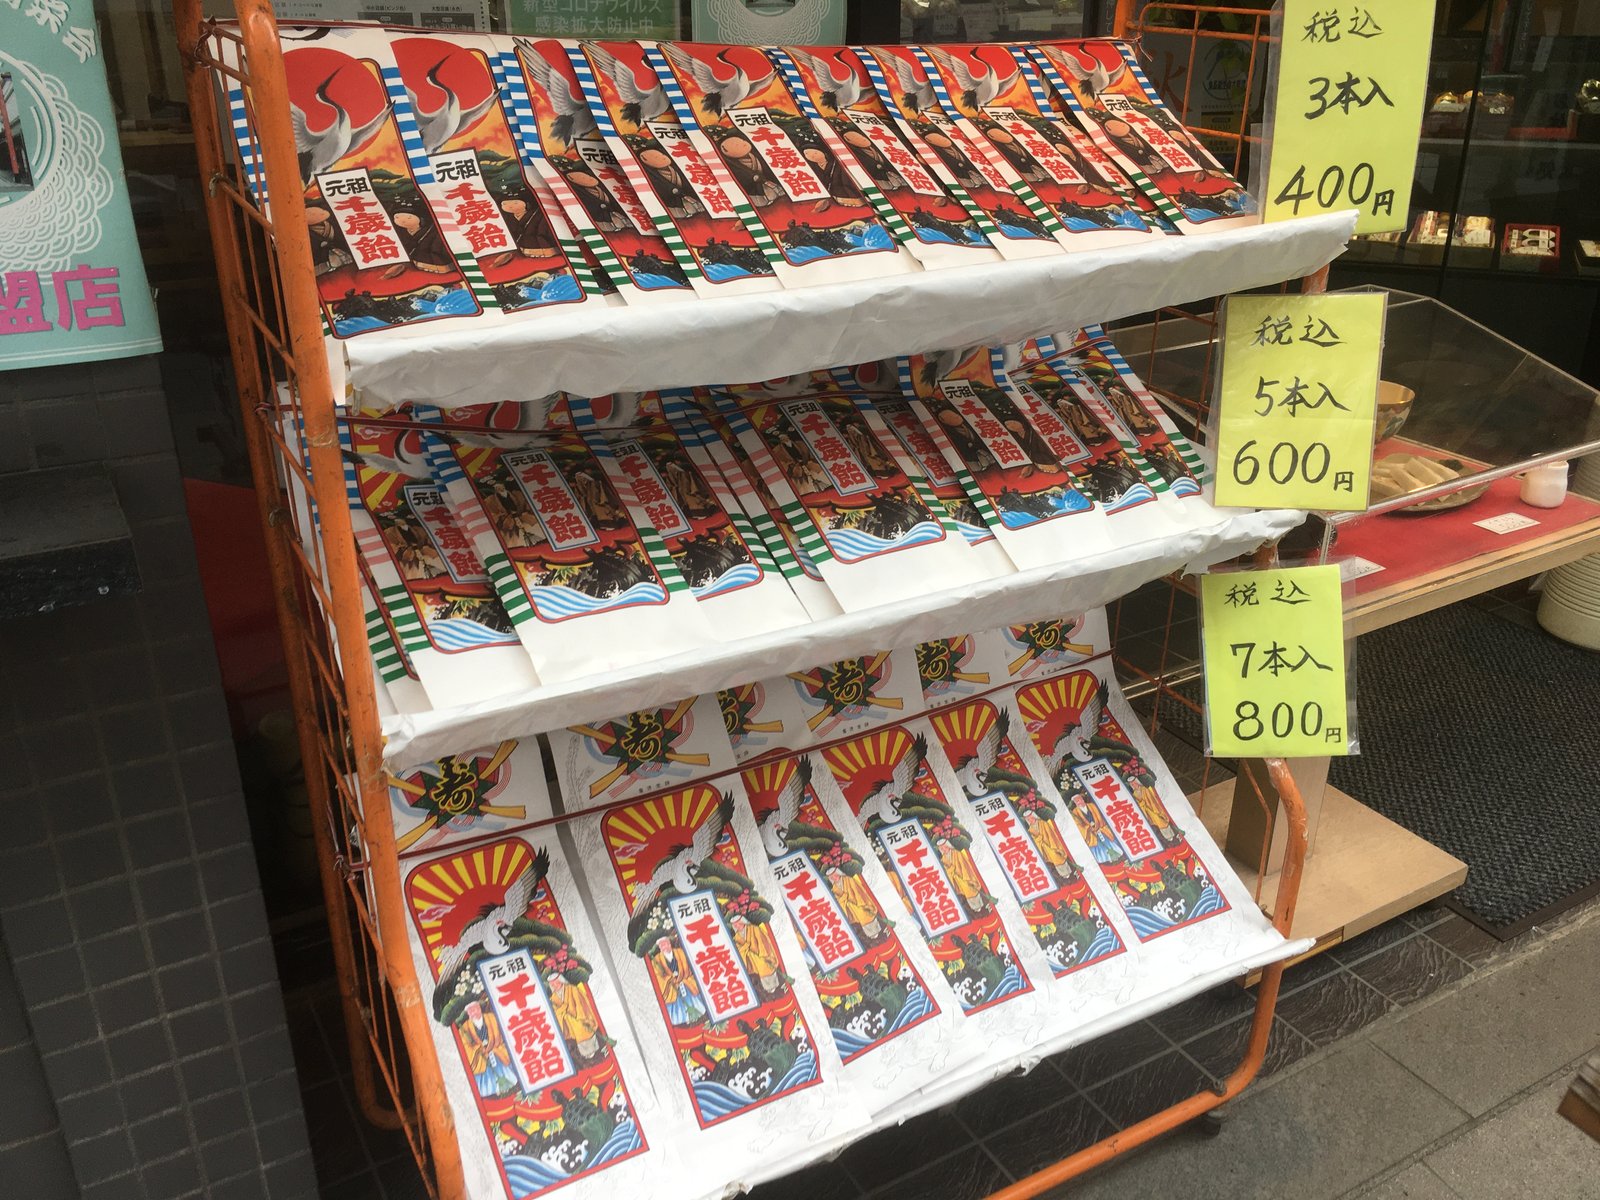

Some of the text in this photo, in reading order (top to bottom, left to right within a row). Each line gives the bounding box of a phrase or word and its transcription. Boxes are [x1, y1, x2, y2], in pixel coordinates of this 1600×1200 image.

[535, 16, 654, 35] 感染拡大防止中
[1302, 7, 1384, 43] 税込
[989, 111, 1021, 121] 元祖
[1104, 99, 1133, 111] 元祖
[1304, 71, 1395, 121] 3本入
[734, 114, 772, 127] 元祖
[852, 114, 883, 126] 元祖
[864, 126, 937, 192] 千歳飴
[1006, 121, 1083, 181] 千歳飴
[1118, 112, 1193, 169] 千歳飴
[436, 158, 479, 183] 元祖
[750, 126, 821, 197] 千歳飴
[325, 177, 371, 197] 元祖
[1274, 162, 1395, 216] 400円
[334, 195, 400, 264] 千歳飴
[444, 182, 508, 253] 千歳飴
[1251, 315, 1347, 347] 税込
[788, 402, 820, 416] 元祖
[945, 386, 975, 399] 元祖
[1255, 376, 1352, 418] 5本入
[801, 415, 868, 487] 千歳飴
[959, 399, 1024, 464] 千歳飴
[510, 453, 547, 467] 元祖
[1233, 440, 1353, 493] 600円
[521, 463, 588, 543] 千歳飴
[1224, 580, 1311, 608] 税込
[1230, 641, 1334, 679] 7本入
[1233, 700, 1342, 744] 800円
[1081, 763, 1109, 780] 元祖
[975, 798, 1005, 818] 元祖
[1090, 775, 1154, 853] 千歳飴
[886, 824, 919, 845] 元祖
[987, 812, 1049, 895] 千歳飴
[773, 857, 806, 881] 元祖
[897, 839, 960, 928] 千歳飴
[678, 899, 711, 919] 元祖
[783, 872, 854, 961] 千歳飴
[488, 957, 527, 980] 元祖
[684, 914, 748, 1015] 千歳飴
[496, 973, 564, 1085] 千歳飴
